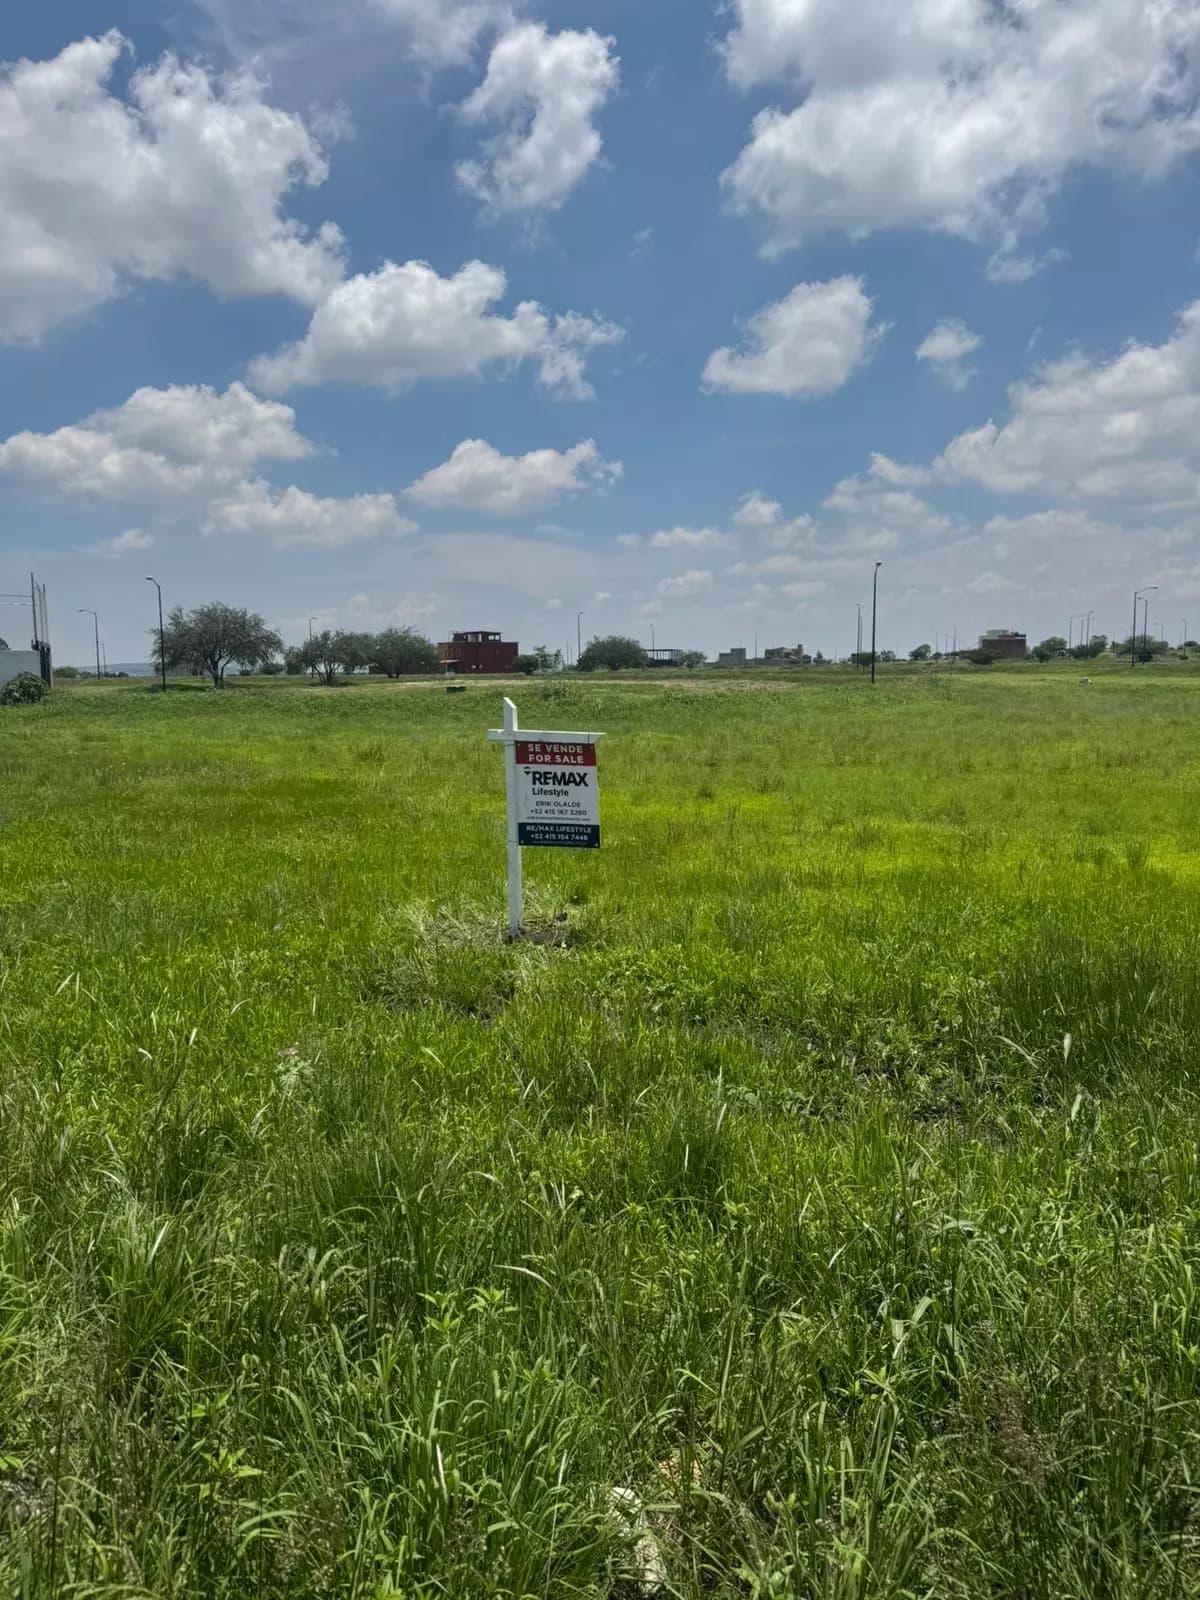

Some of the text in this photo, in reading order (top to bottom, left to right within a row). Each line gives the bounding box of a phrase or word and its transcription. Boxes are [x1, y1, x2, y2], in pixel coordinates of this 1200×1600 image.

[528, 743, 583, 753] SE VENDE
[528, 754, 584, 763] FOR SALE
